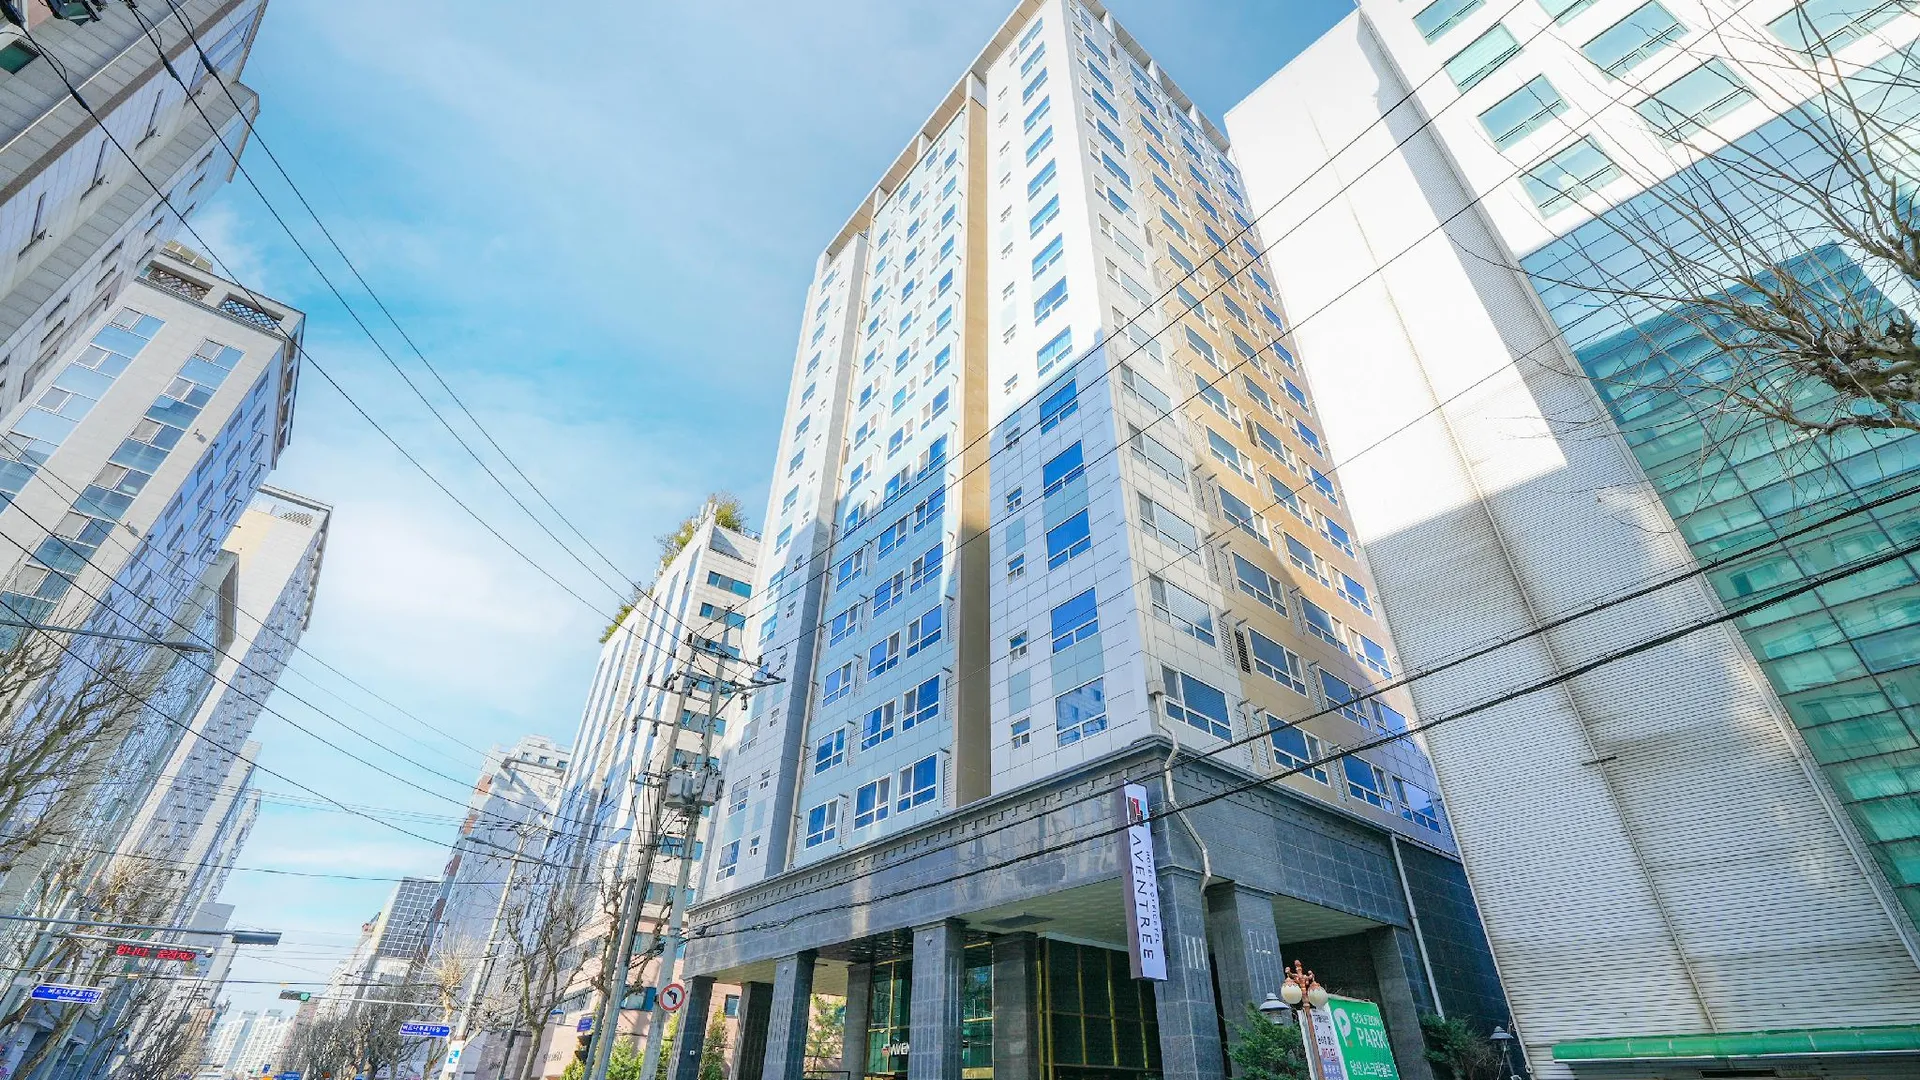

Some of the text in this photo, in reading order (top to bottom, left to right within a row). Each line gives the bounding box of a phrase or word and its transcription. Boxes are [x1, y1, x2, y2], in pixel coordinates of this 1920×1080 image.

[1132, 834, 1154, 959] AVENTREE
[1351, 1012, 1381, 1026] GOLFZON
[1356, 1027, 1388, 1049] PARK
